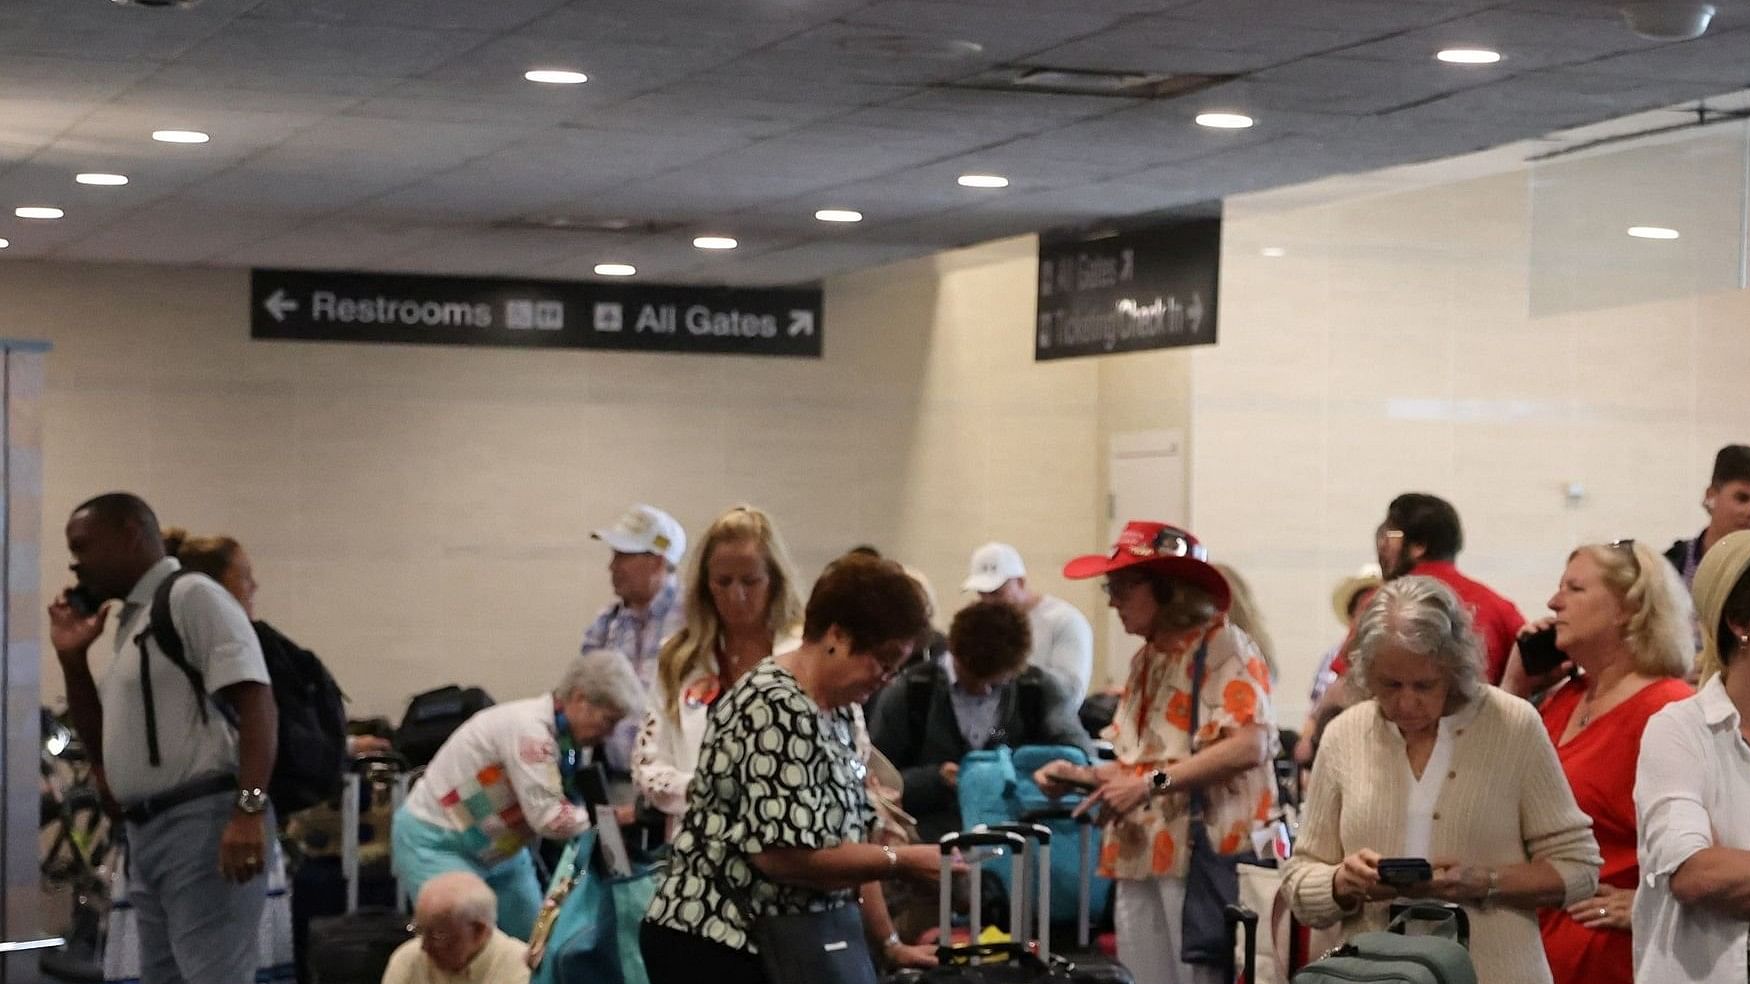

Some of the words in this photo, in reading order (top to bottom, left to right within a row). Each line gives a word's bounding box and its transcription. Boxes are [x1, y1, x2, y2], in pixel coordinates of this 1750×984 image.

[311, 290, 493, 327] Restrooms
[635, 304, 677, 333] All
[685, 304, 778, 338] Gates
